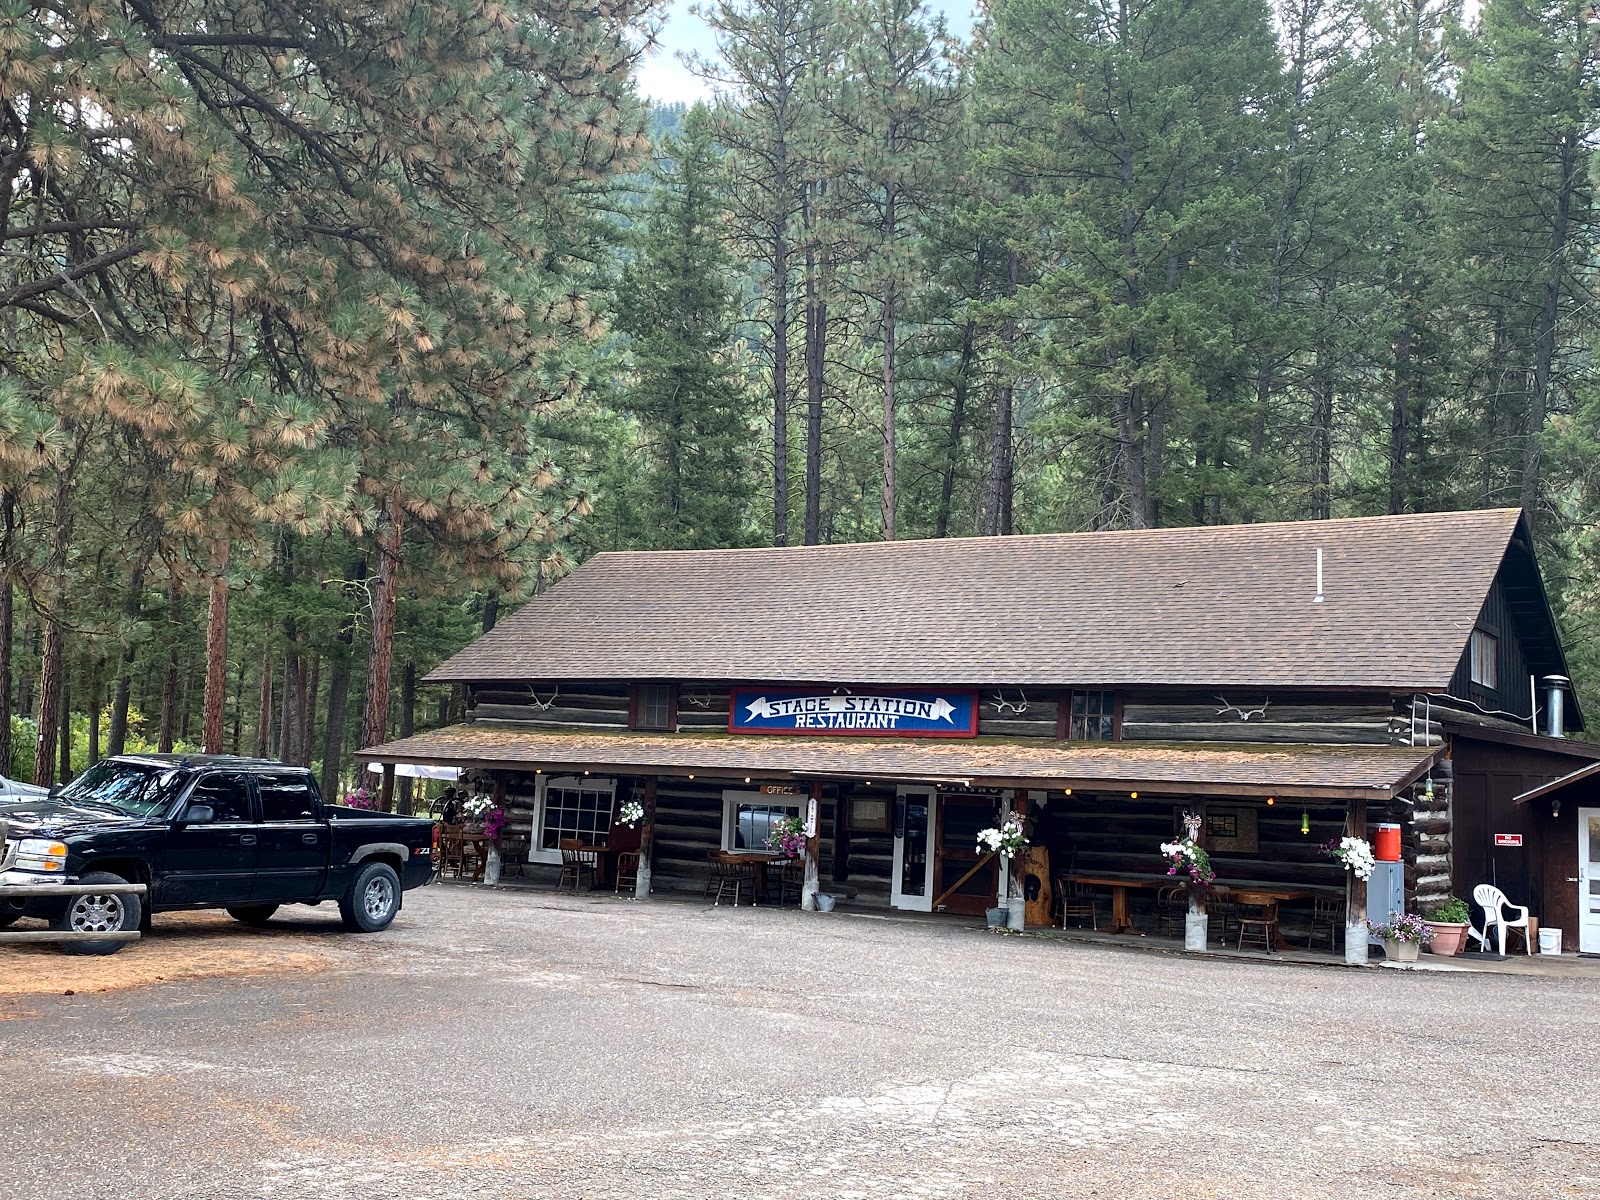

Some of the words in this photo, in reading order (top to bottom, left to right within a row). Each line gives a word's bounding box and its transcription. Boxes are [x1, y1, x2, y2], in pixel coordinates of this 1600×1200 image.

[769, 698, 830, 716] STAGE
[845, 698, 932, 717] STATION
[795, 713, 900, 729] RESTAURANT
[767, 785, 793, 795] OFFICE
[413, 847, 430, 855] Z71
